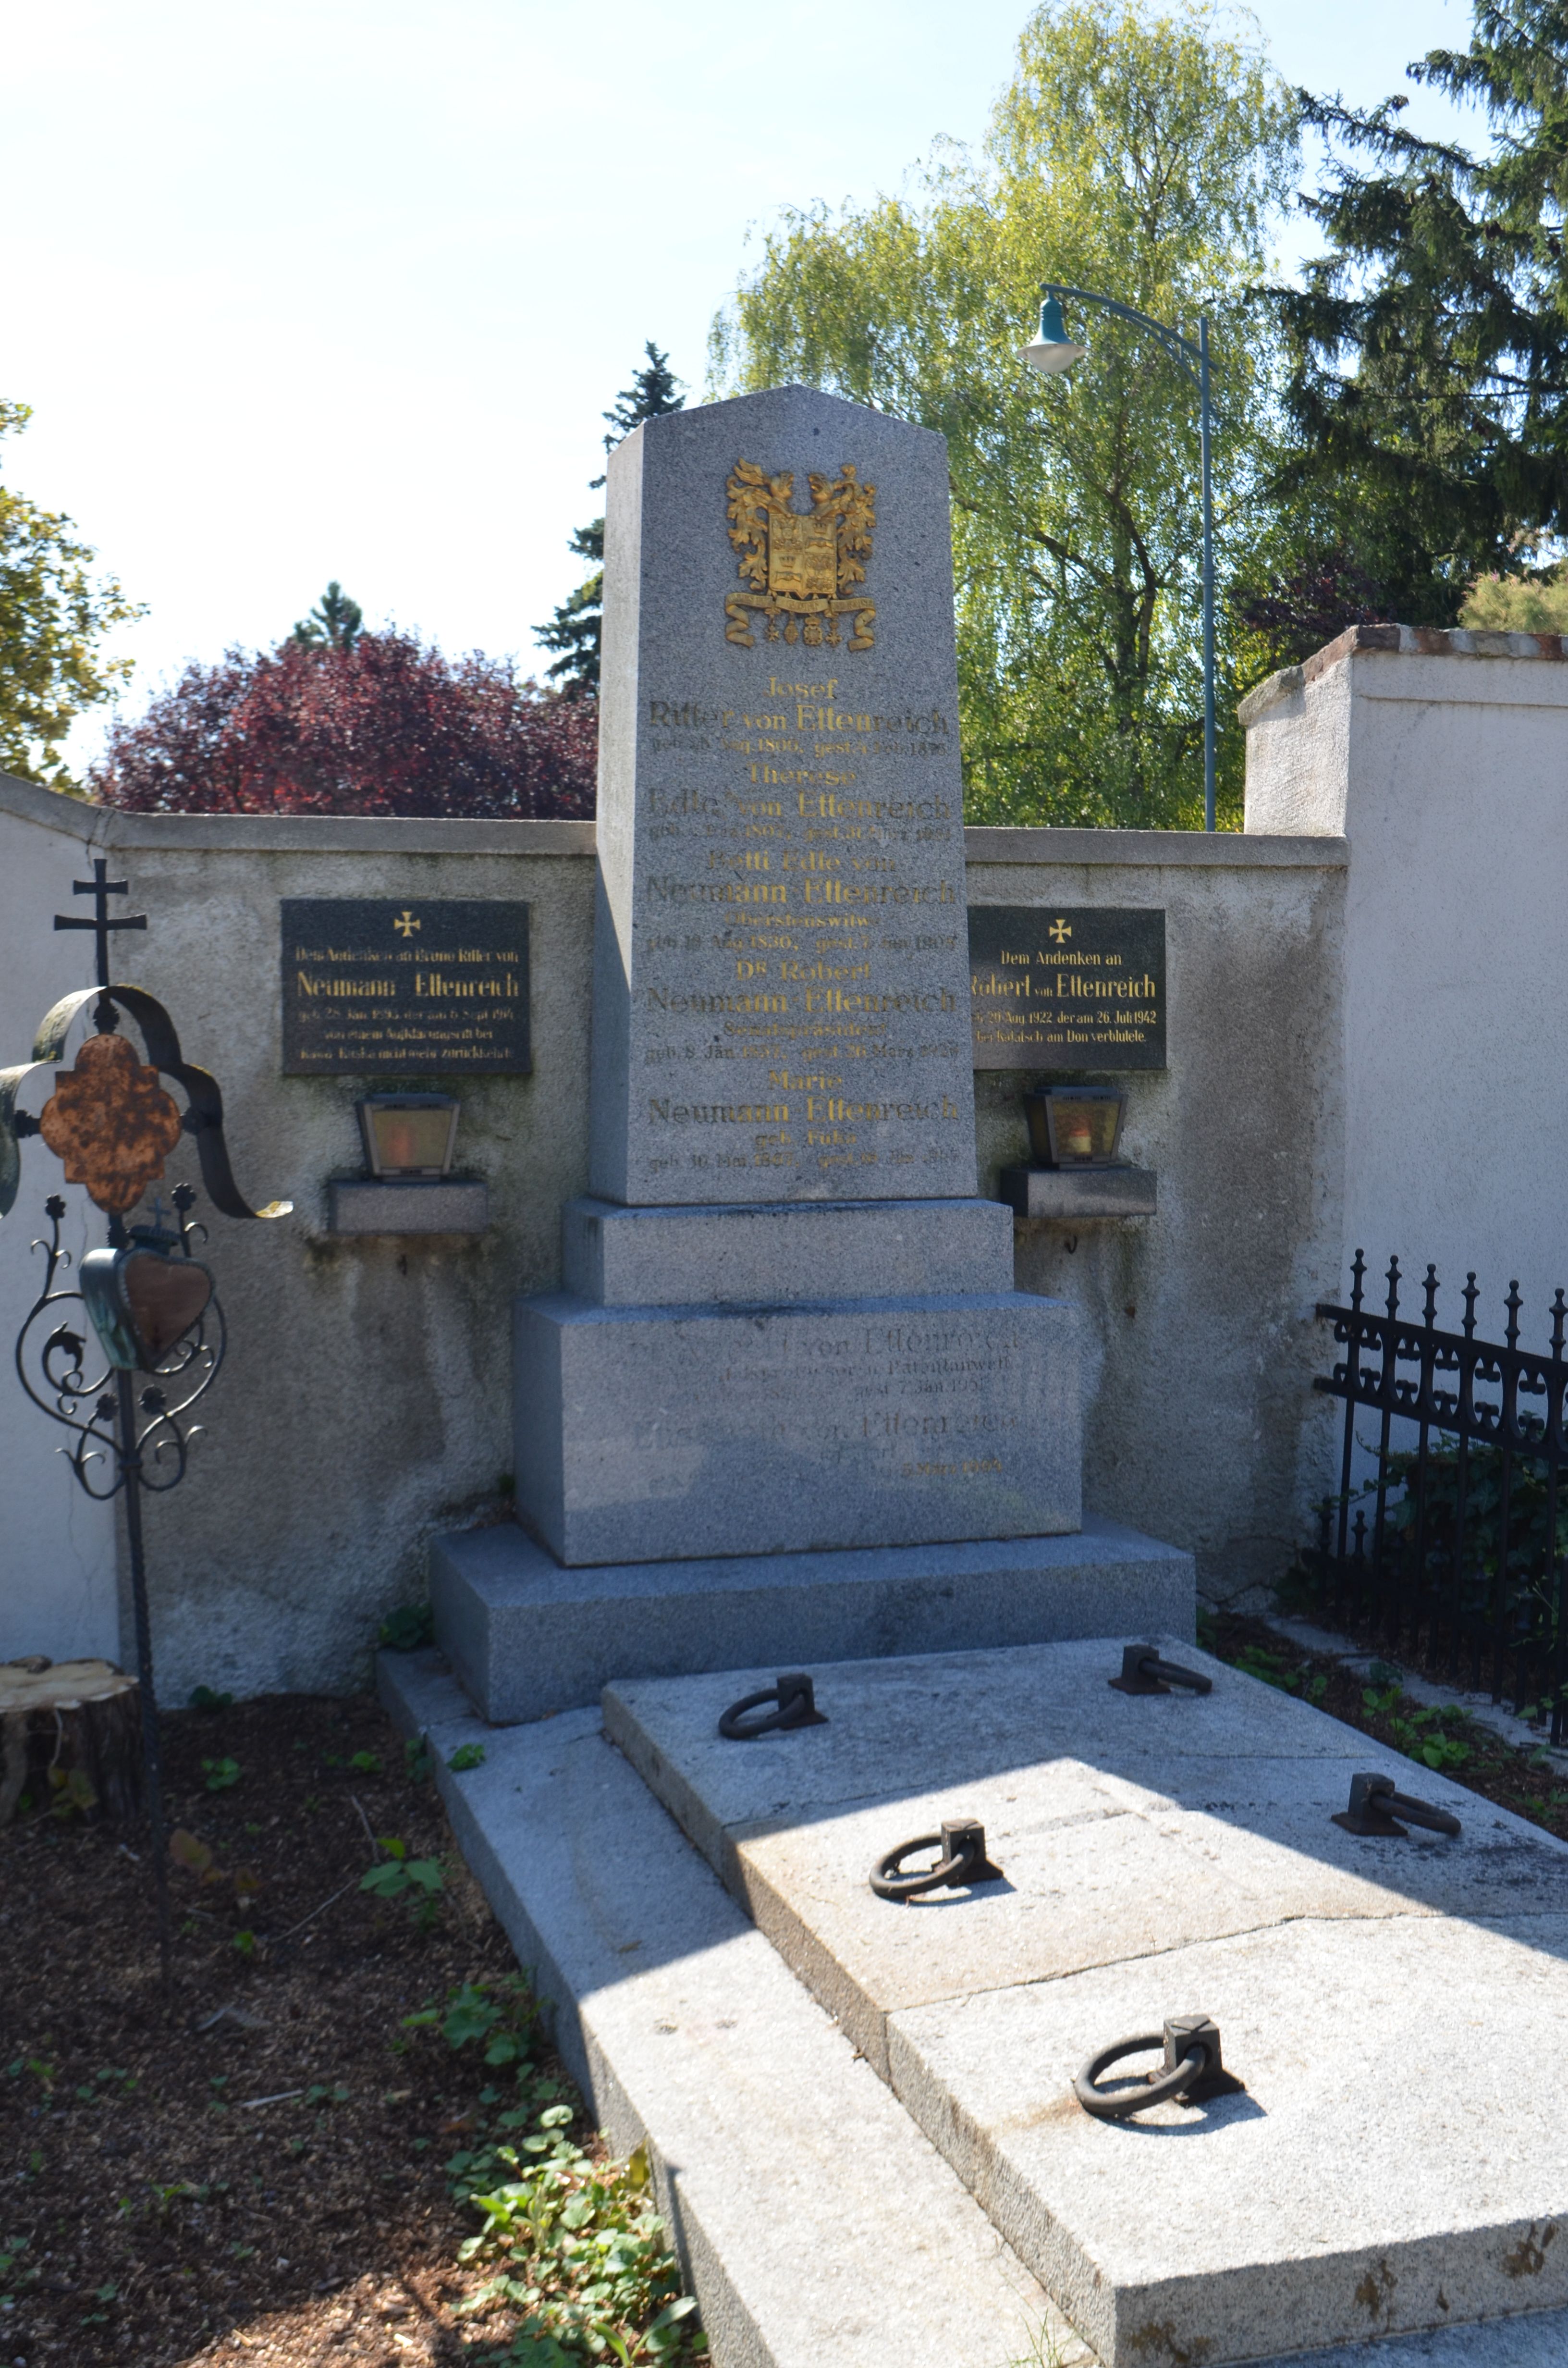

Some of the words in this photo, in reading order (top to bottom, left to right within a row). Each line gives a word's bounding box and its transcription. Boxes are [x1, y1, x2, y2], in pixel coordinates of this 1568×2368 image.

[764, 677, 838, 700] Josef
[649, 701, 734, 728] Ritter
[742, 714, 787, 731] von
[796, 704, 950, 734] Ettenreich
[748, 763, 857, 786] Therese
[649, 787, 719, 815] Edle
[738, 801, 782, 816] von
[798, 790, 950, 818] Ettenreich
[708, 850, 771, 871] Betti
[782, 849, 840, 871] Edle
[851, 858, 896, 872] von
[1000, 950, 1030, 965] Dem
[1036, 950, 1101, 965] Andenken
[1105, 954, 1122, 965] an
[780, 960, 871, 982] Robert
[1034, 987, 1054, 997] von
[1057, 973, 1156, 998] Ettenreich
[1057, 1011, 1076, 1024] der
[1077, 1014, 1093, 1024] am
[1097, 1011, 1112, 1024] 26.
[1114, 1010, 1132, 1024] Juli
[1134, 1011, 1156, 1024] 1942
[1047, 1033, 1064, 1043] am
[1066, 1029, 1089, 1043] Don
[768, 1069, 843, 1091] Marie
